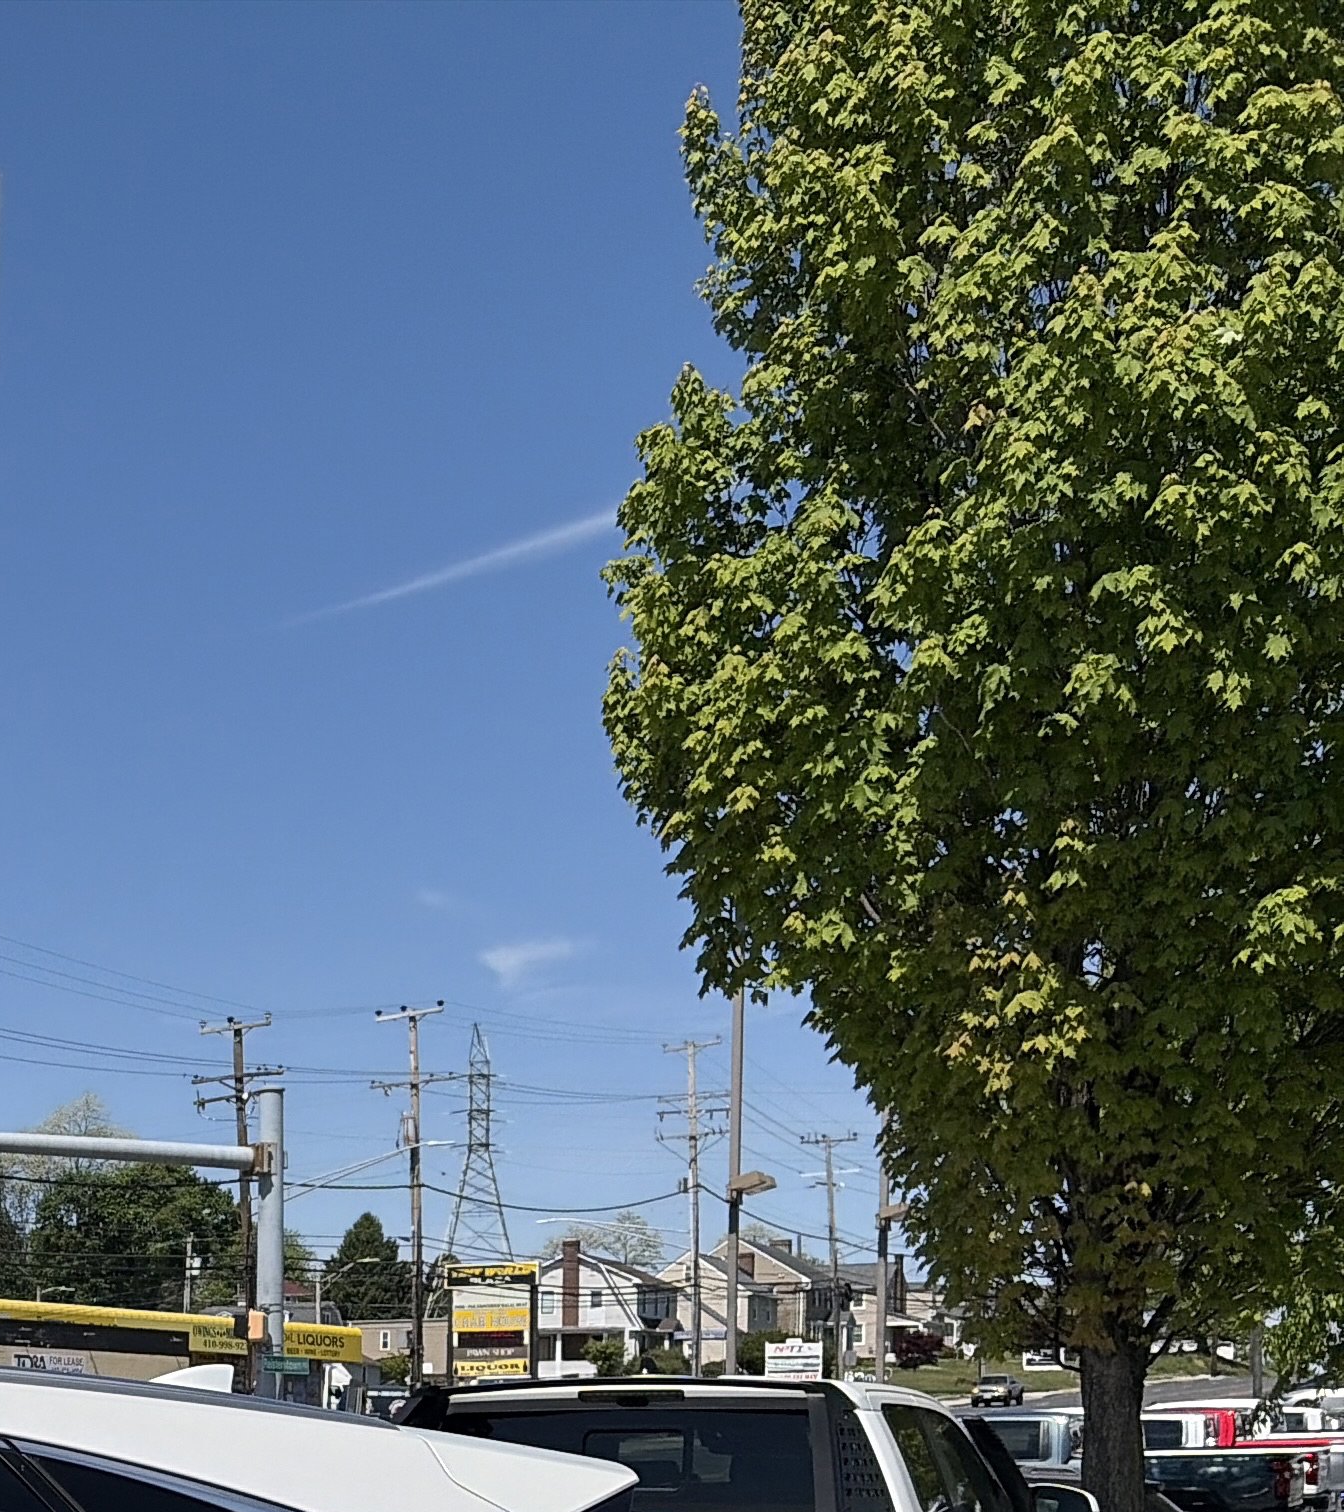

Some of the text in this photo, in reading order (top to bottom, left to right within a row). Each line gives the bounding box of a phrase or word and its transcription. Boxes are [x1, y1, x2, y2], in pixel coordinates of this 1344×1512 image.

[203, 1339, 247, 1351] 410-998-92
[297, 1333, 345, 1348] LIQUORS
[50, 1355, 62, 1365] FOR
[64, 1357, 84, 1367] LEASE
[460, 1362, 521, 1372] LIQUOR
